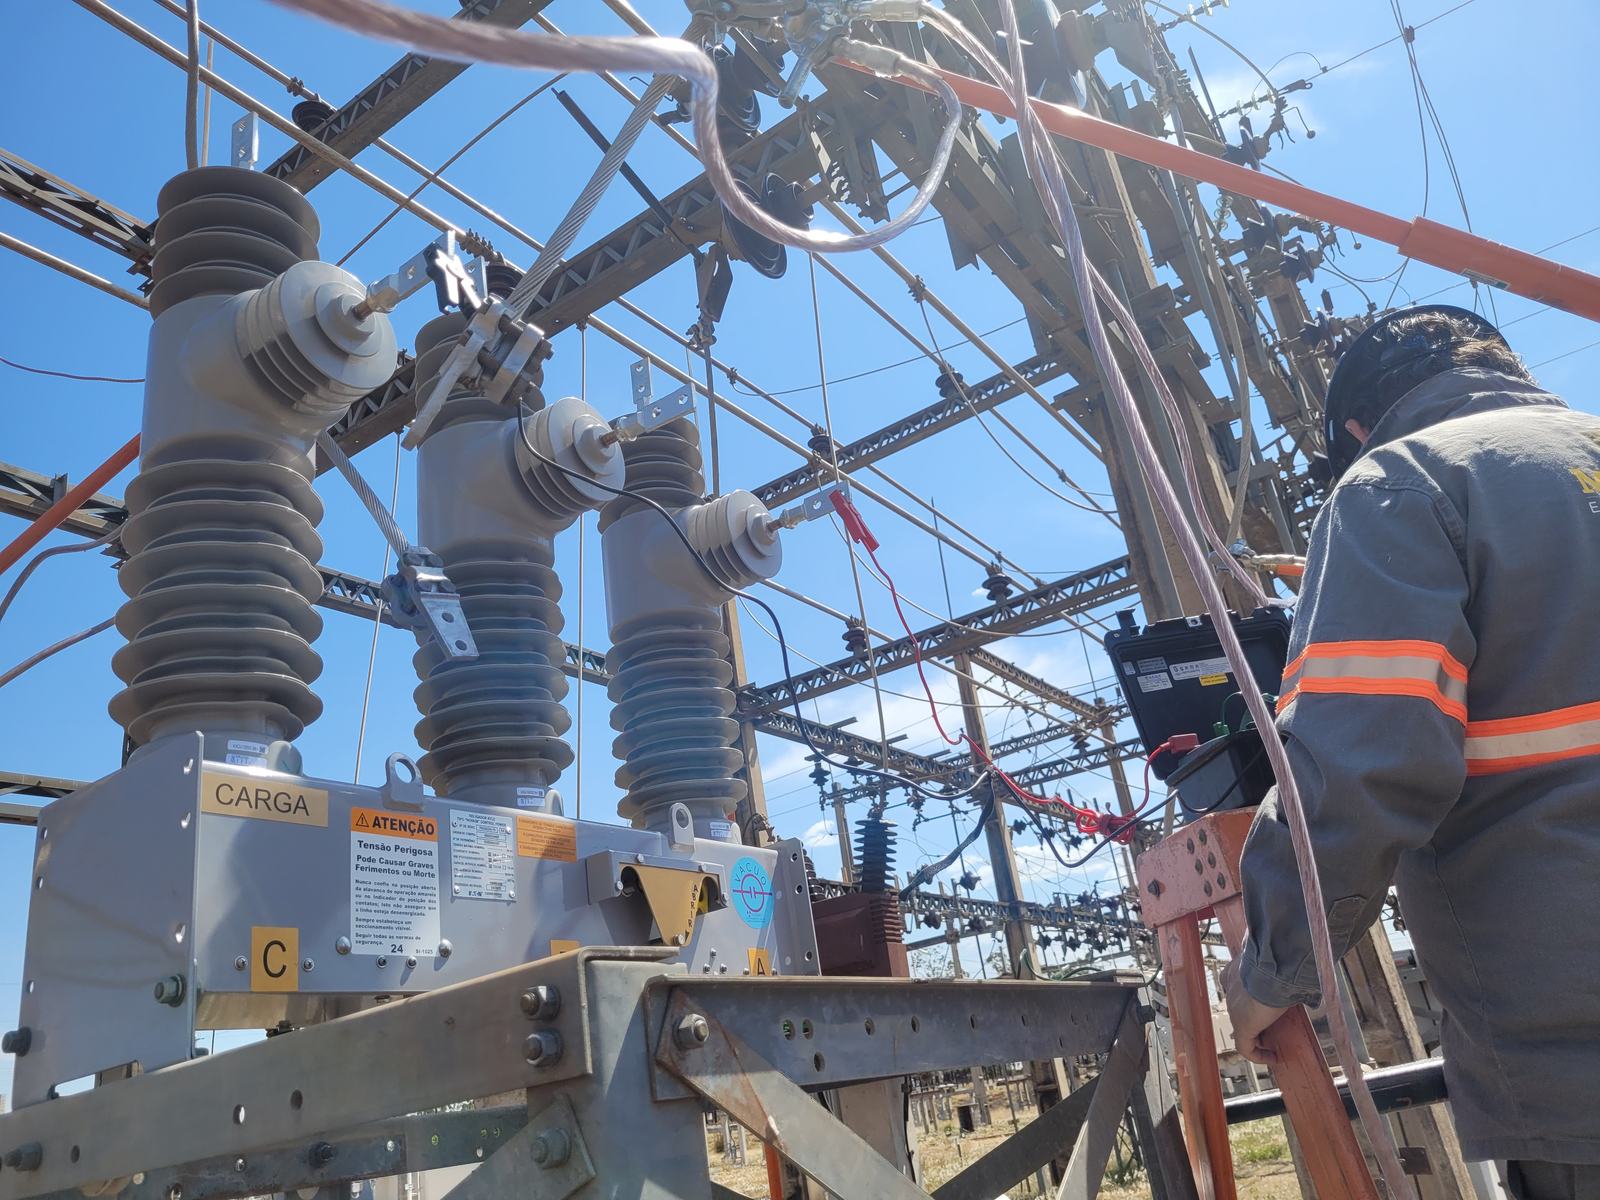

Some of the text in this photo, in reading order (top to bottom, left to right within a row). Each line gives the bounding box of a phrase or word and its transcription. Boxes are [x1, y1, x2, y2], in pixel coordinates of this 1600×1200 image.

[215, 783, 310, 817] CARGA
[372, 815, 435, 836] ATENÇÃO
[357, 840, 433, 857] Tensão Perigosa
[356, 854, 434, 870] Pode Causar Graves
[355, 863, 400, 875] Ferimentos
[413, 869, 436, 879] Morte
[399, 882, 419, 890] posição
[687, 884, 698, 928] ABRIR
[390, 943, 404, 954] 24
[263, 940, 287, 978] C
[757, 957, 766, 975] A
